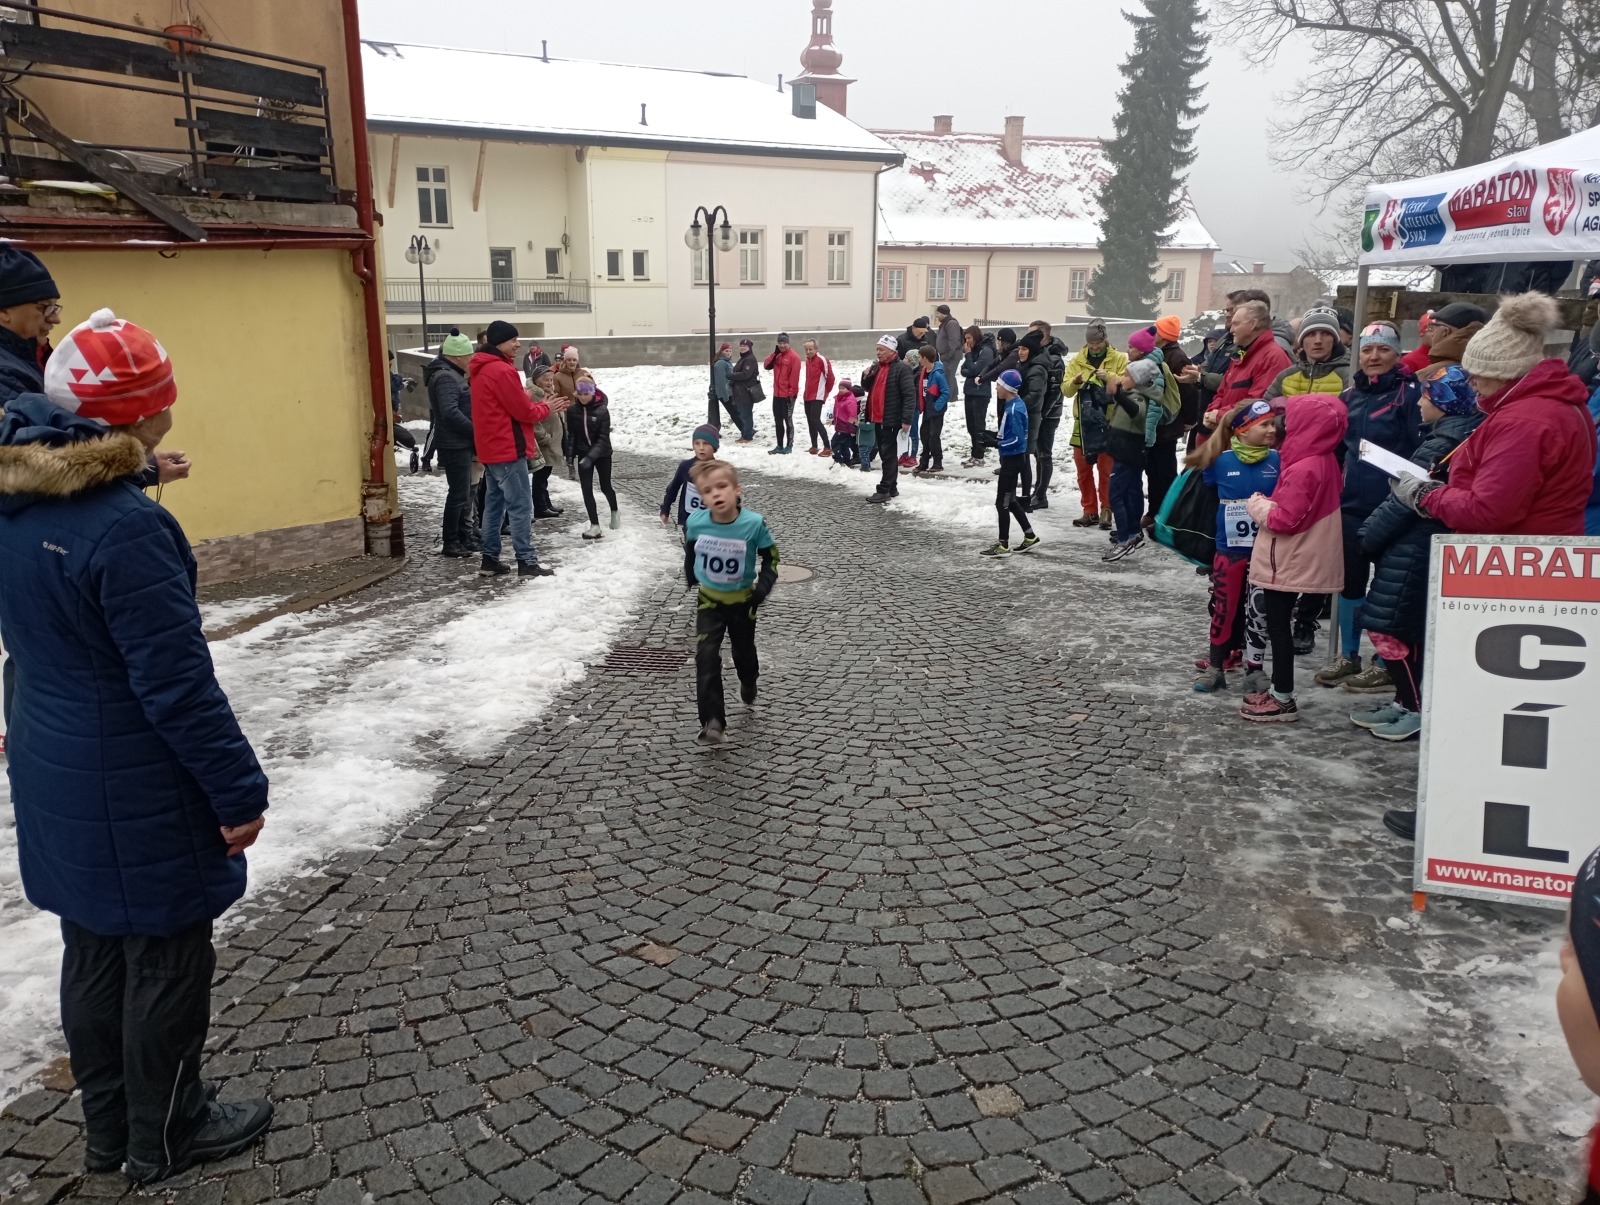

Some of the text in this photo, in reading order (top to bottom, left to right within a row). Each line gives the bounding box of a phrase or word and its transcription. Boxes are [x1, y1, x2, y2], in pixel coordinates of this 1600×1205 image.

[1448, 169, 1538, 212] MARATON
[1404, 210, 1441, 228] ATLETICKÝ
[1507, 204, 1529, 218] stav
[1409, 230, 1427, 242] SVAZ
[701, 553, 739, 574] 109
[1442, 601, 1599, 616] tělovýchovná jedno
